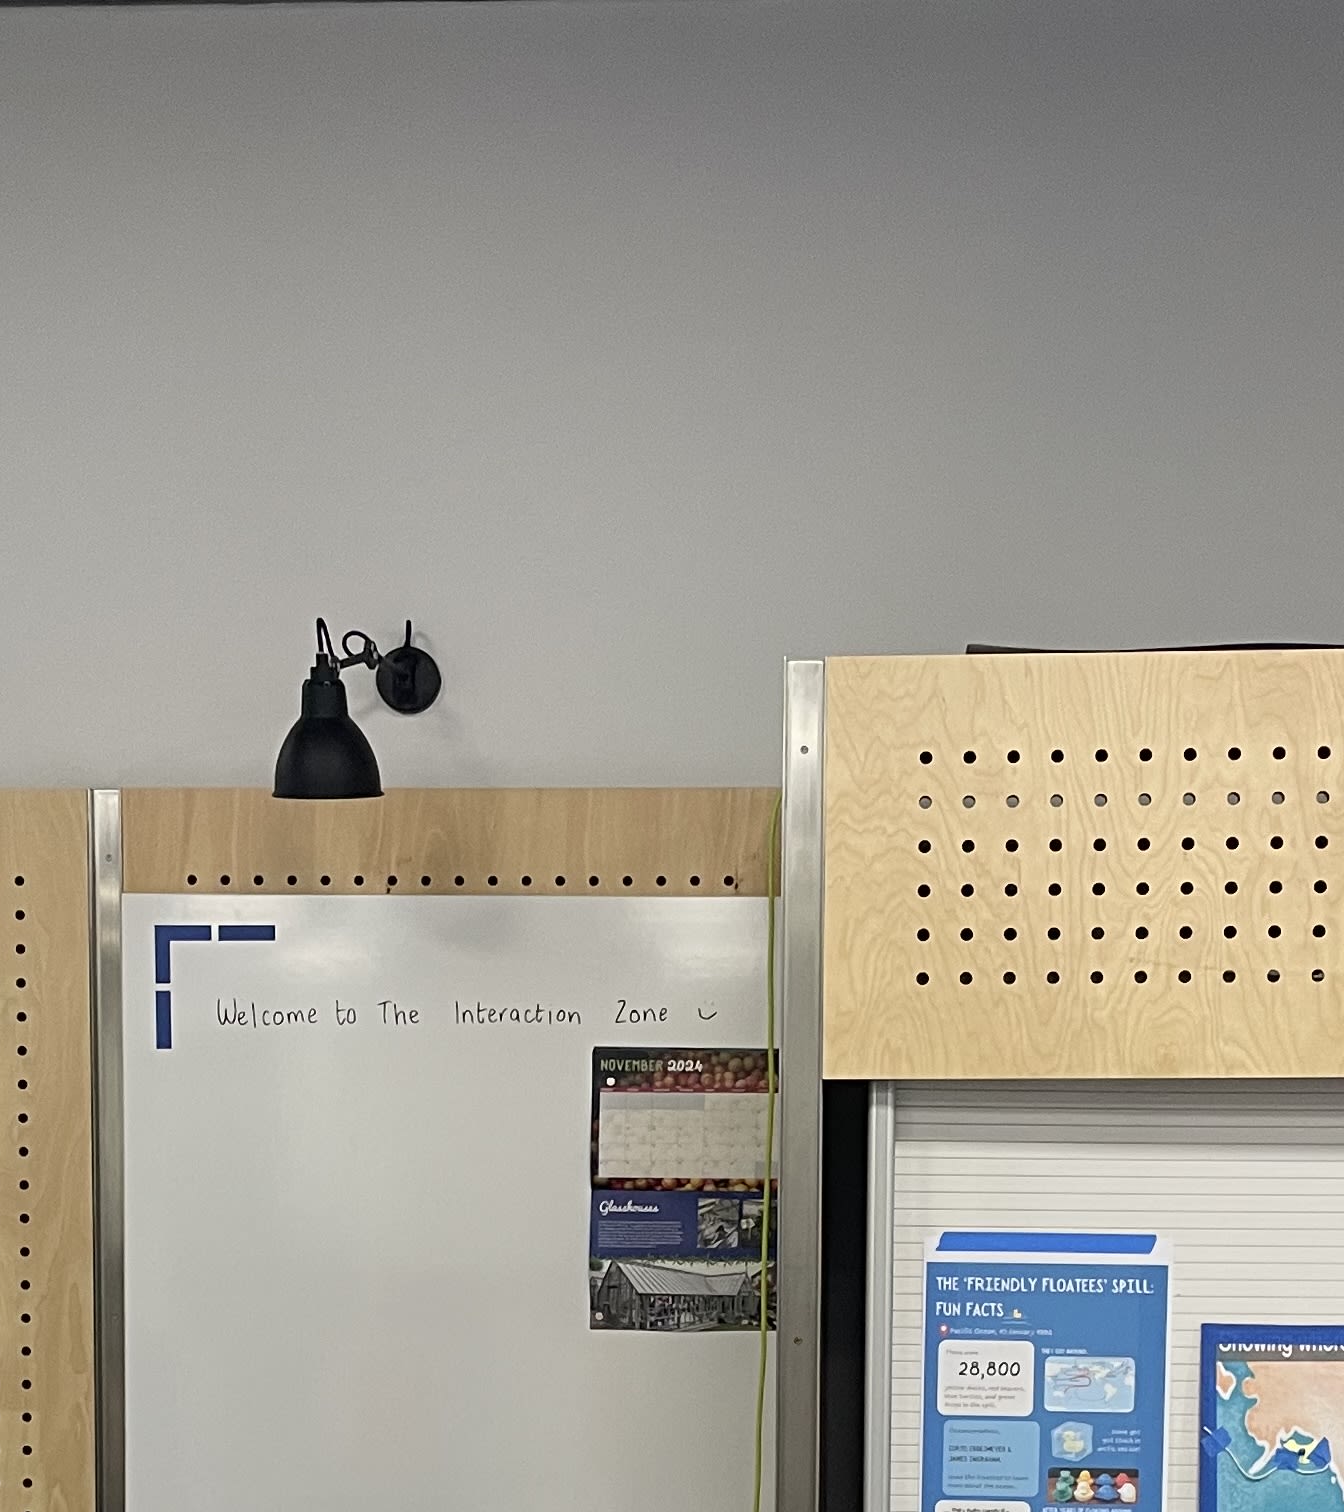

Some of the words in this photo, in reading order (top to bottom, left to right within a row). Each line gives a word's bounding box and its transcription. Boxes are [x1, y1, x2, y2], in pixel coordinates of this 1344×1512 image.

[217, 999, 318, 1028] Welcome
[335, 998, 357, 1026] to
[377, 1000, 420, 1025] The
[455, 999, 582, 1025] Interaction
[614, 998, 668, 1025] Zone
[600, 1058, 663, 1072] NOVEMBER
[667, 1059, 704, 1073] 2024
[935, 1276, 959, 1291] THE
[1111, 1278, 1154, 1294] SPILL:
[935, 1301, 961, 1317] FUN
[965, 1302, 1004, 1318] FACTS
[958, 1361, 1021, 1380] 28,800
